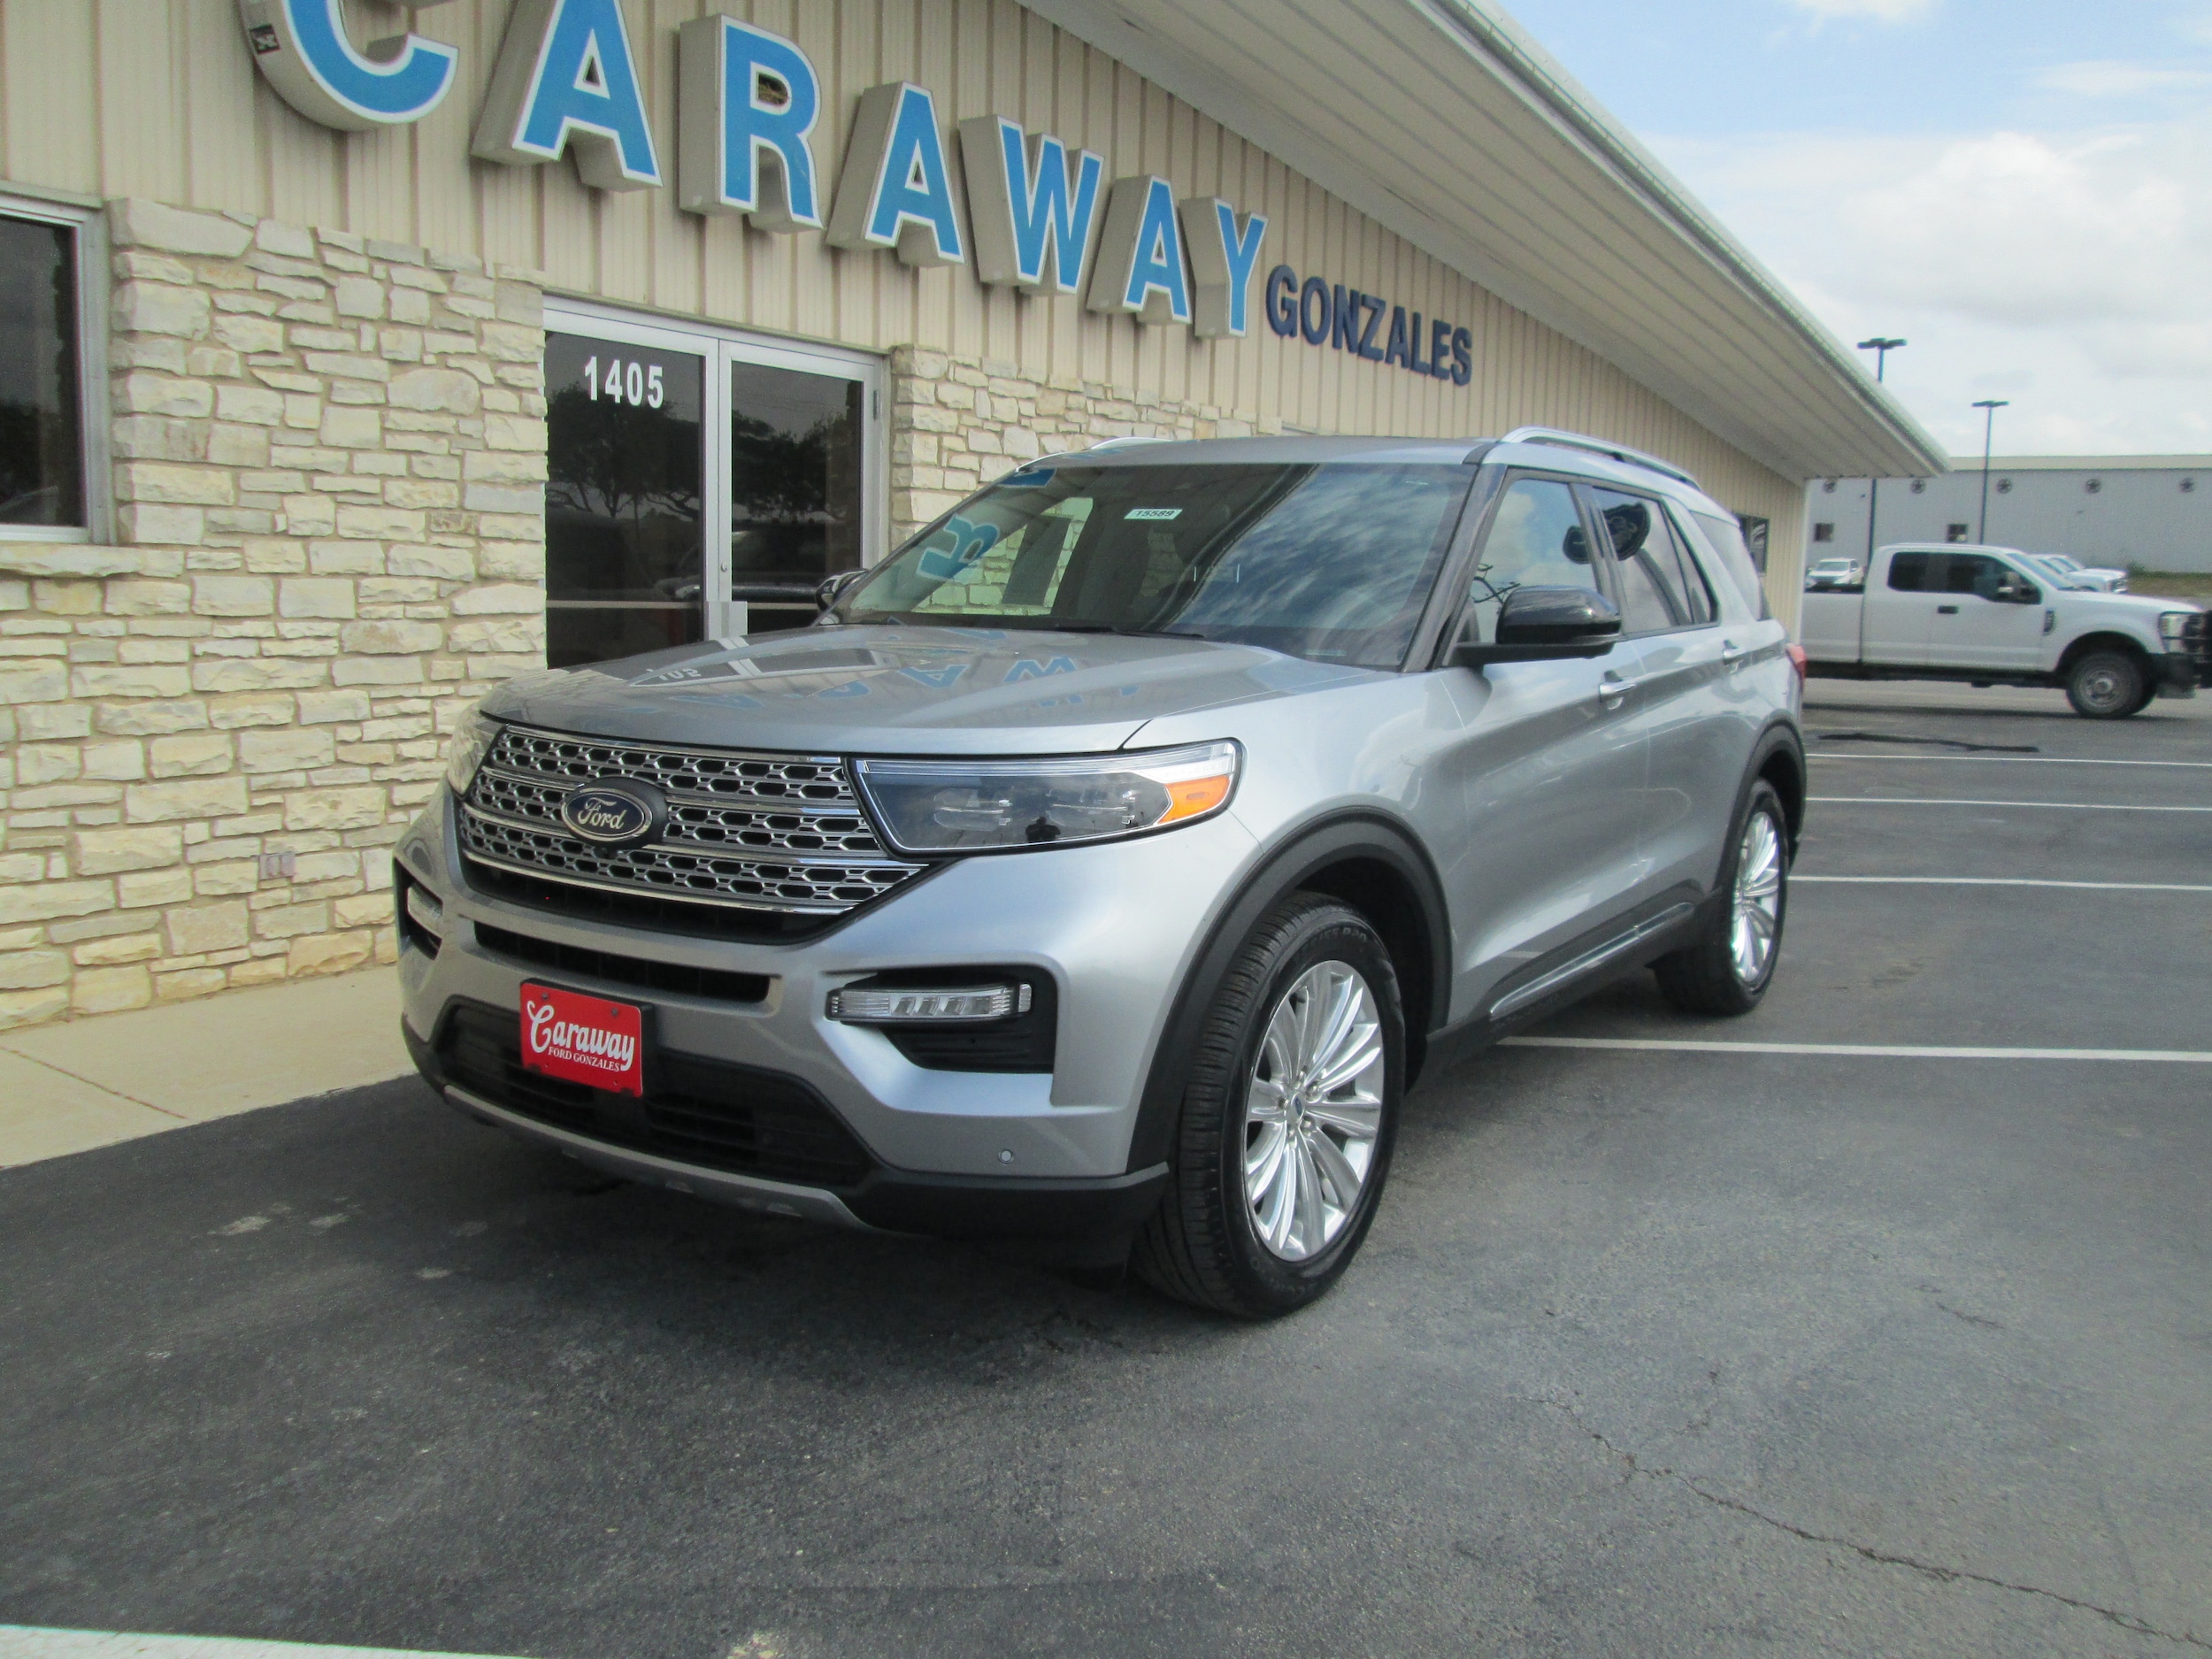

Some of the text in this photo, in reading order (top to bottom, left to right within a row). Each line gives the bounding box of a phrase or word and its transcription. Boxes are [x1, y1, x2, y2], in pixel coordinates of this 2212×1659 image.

[1265, 264, 1473, 387] GONZALES
[584, 355, 664, 410] 1405
[577, 796, 627, 830] Ford
[526, 1000, 635, 1071] Caraway
[548, 1046, 620, 1072] FORD GONZALES
